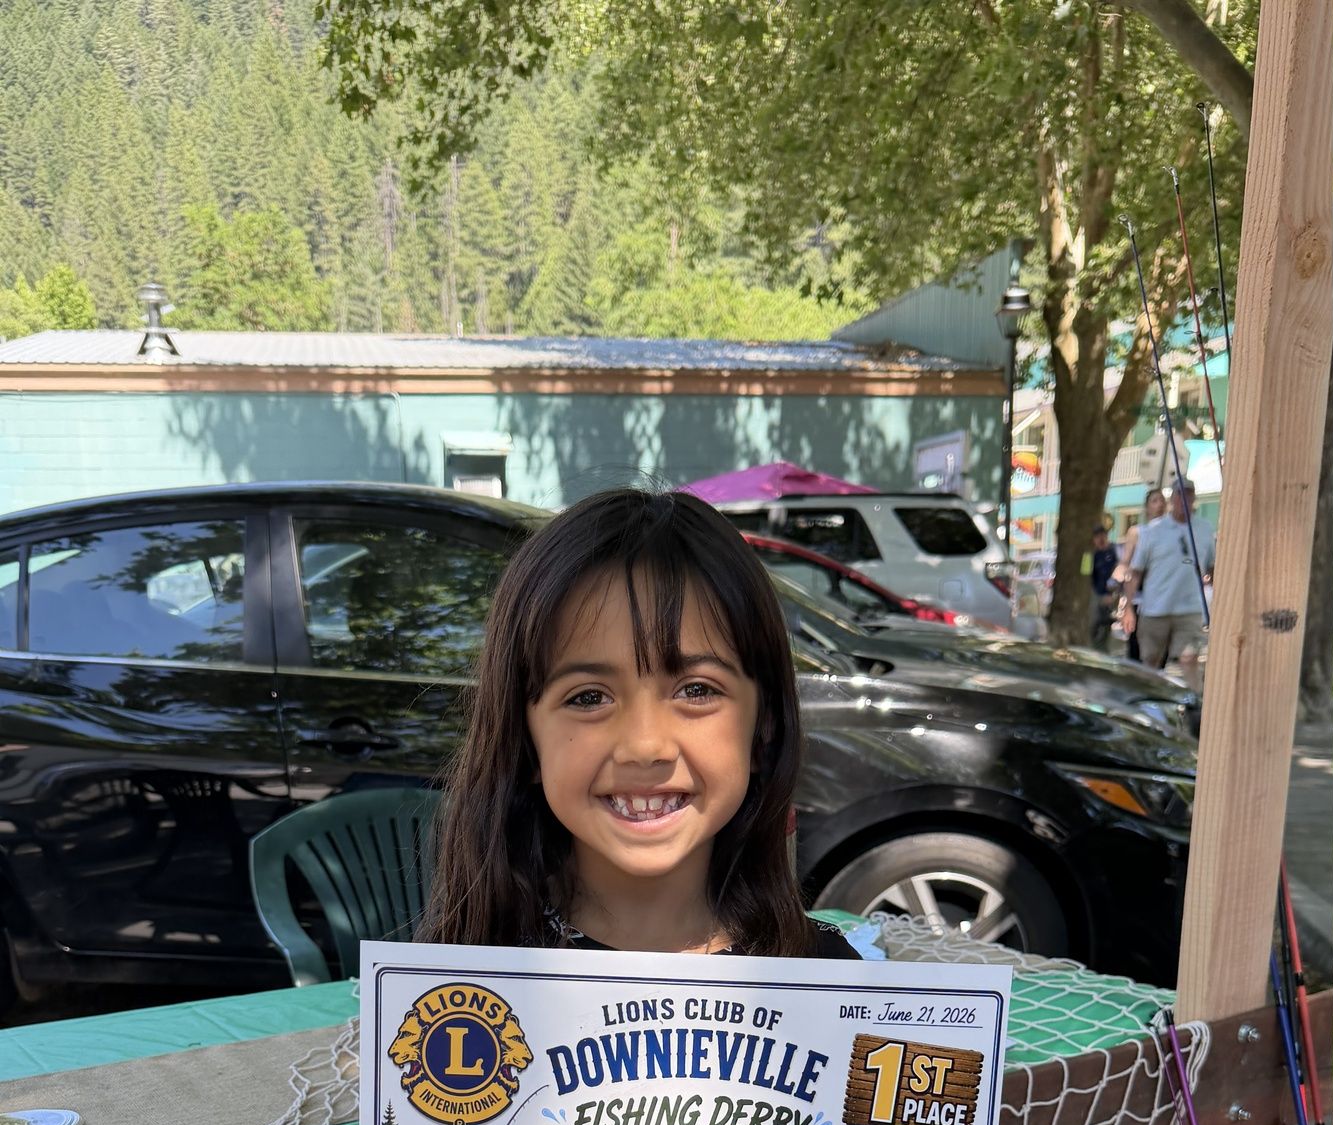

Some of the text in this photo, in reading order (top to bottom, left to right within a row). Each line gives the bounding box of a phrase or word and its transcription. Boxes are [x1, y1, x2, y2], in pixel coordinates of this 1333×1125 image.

[423, 990, 502, 1019] LIONS
[602, 998, 783, 1031] LIONS CLUB OF
[839, 1002, 977, 1024] DATE: June 21, 2026
[445, 1027, 485, 1076] L
[546, 1028, 829, 1103] DOWNIEVILLE
[419, 1088, 502, 1115] INTERNATIONAL
